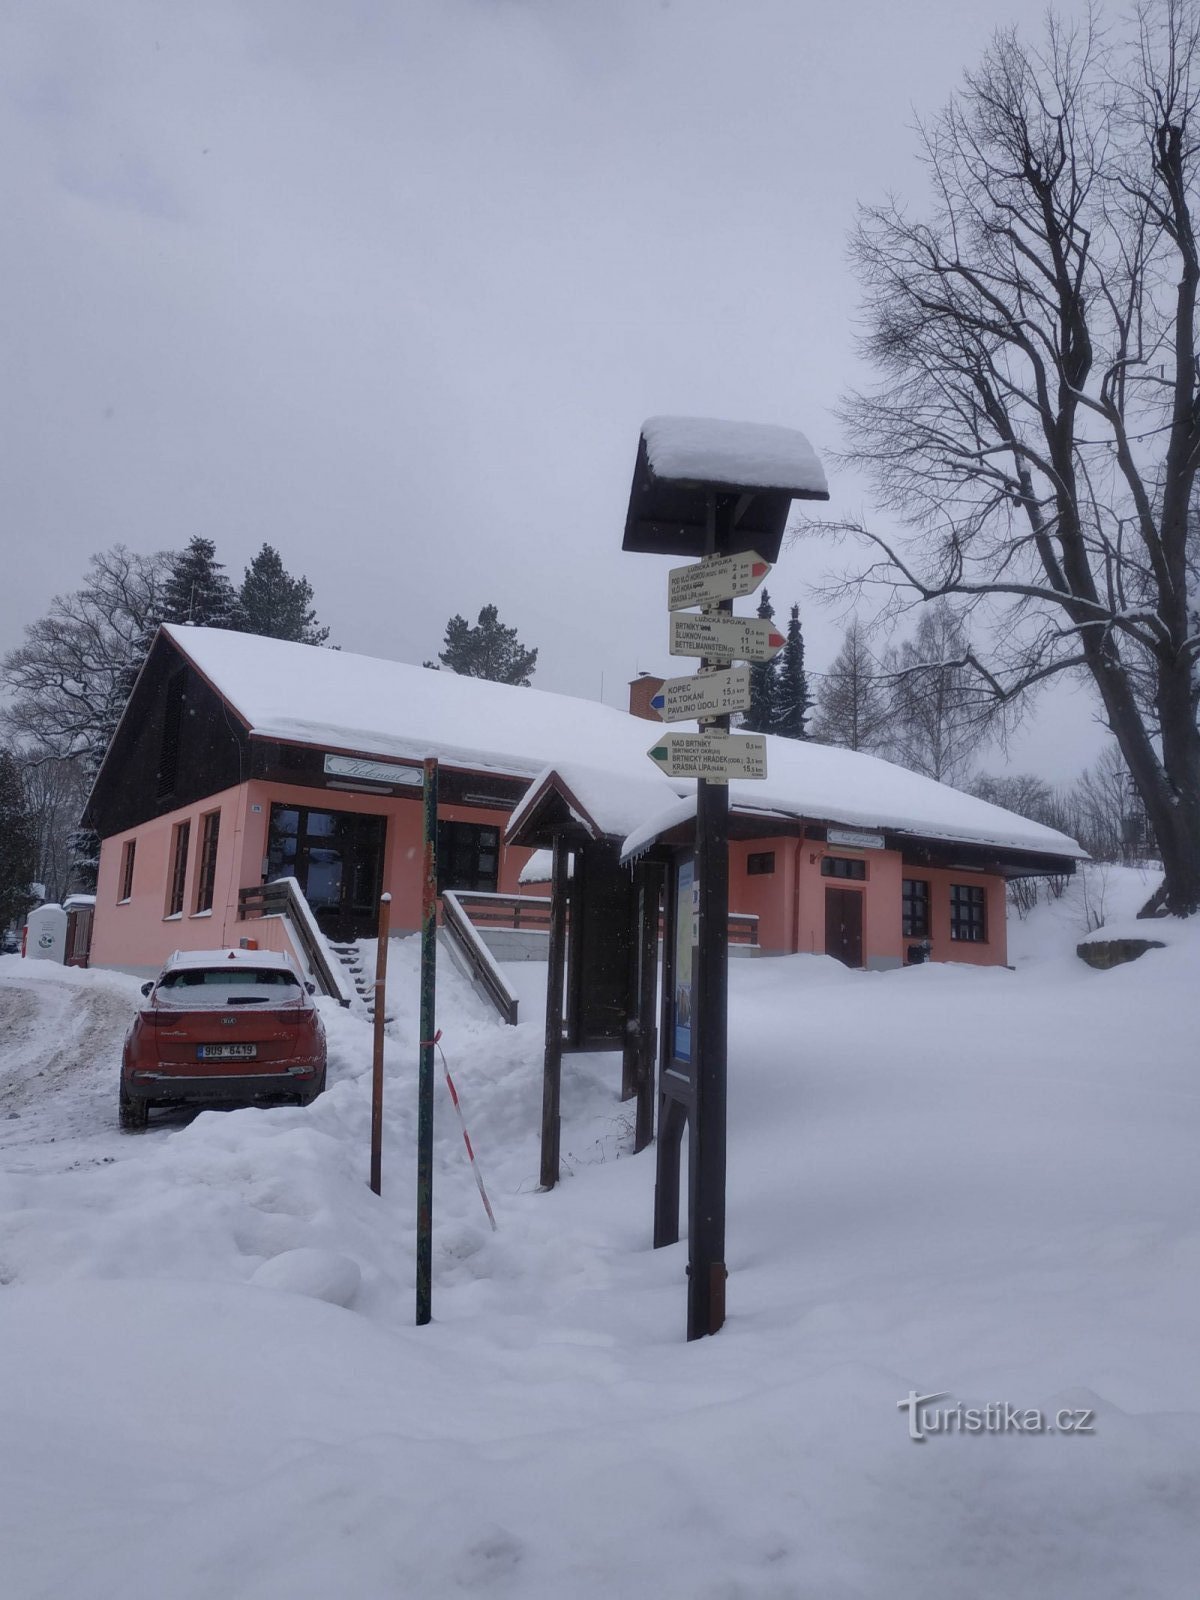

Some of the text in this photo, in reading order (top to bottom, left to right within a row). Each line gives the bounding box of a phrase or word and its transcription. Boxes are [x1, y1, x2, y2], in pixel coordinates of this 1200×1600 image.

[711, 559, 732, 567] SPOJKA
[732, 564, 737, 572] 2
[732, 573, 737, 581] 4
[681, 583, 693, 592] HORA
[732, 582, 737, 590] 9
[722, 617, 747, 626] SPOJKA
[675, 630, 702, 641] ŠLUKNOV
[675, 641, 728, 652] BETTELMANNSTEIN
[726, 677, 731, 685] 2
[668, 684, 691, 694] KOPEC
[668, 691, 705, 705] NA TOKÁNÍ
[668, 703, 696, 715] PAVLINO
[697, 700, 719, 711] ÚDOLÍ
[686, 739, 711, 748] BRTNÍKY
[672, 754, 702, 763] BRTNICKÝ
[703, 754, 728, 763] HRÁDEK
[672, 762, 697, 771] KRÁSNÁ
[698, 762, 711, 772] LÍPA
[205, 1046, 222, 1056] 9U9
